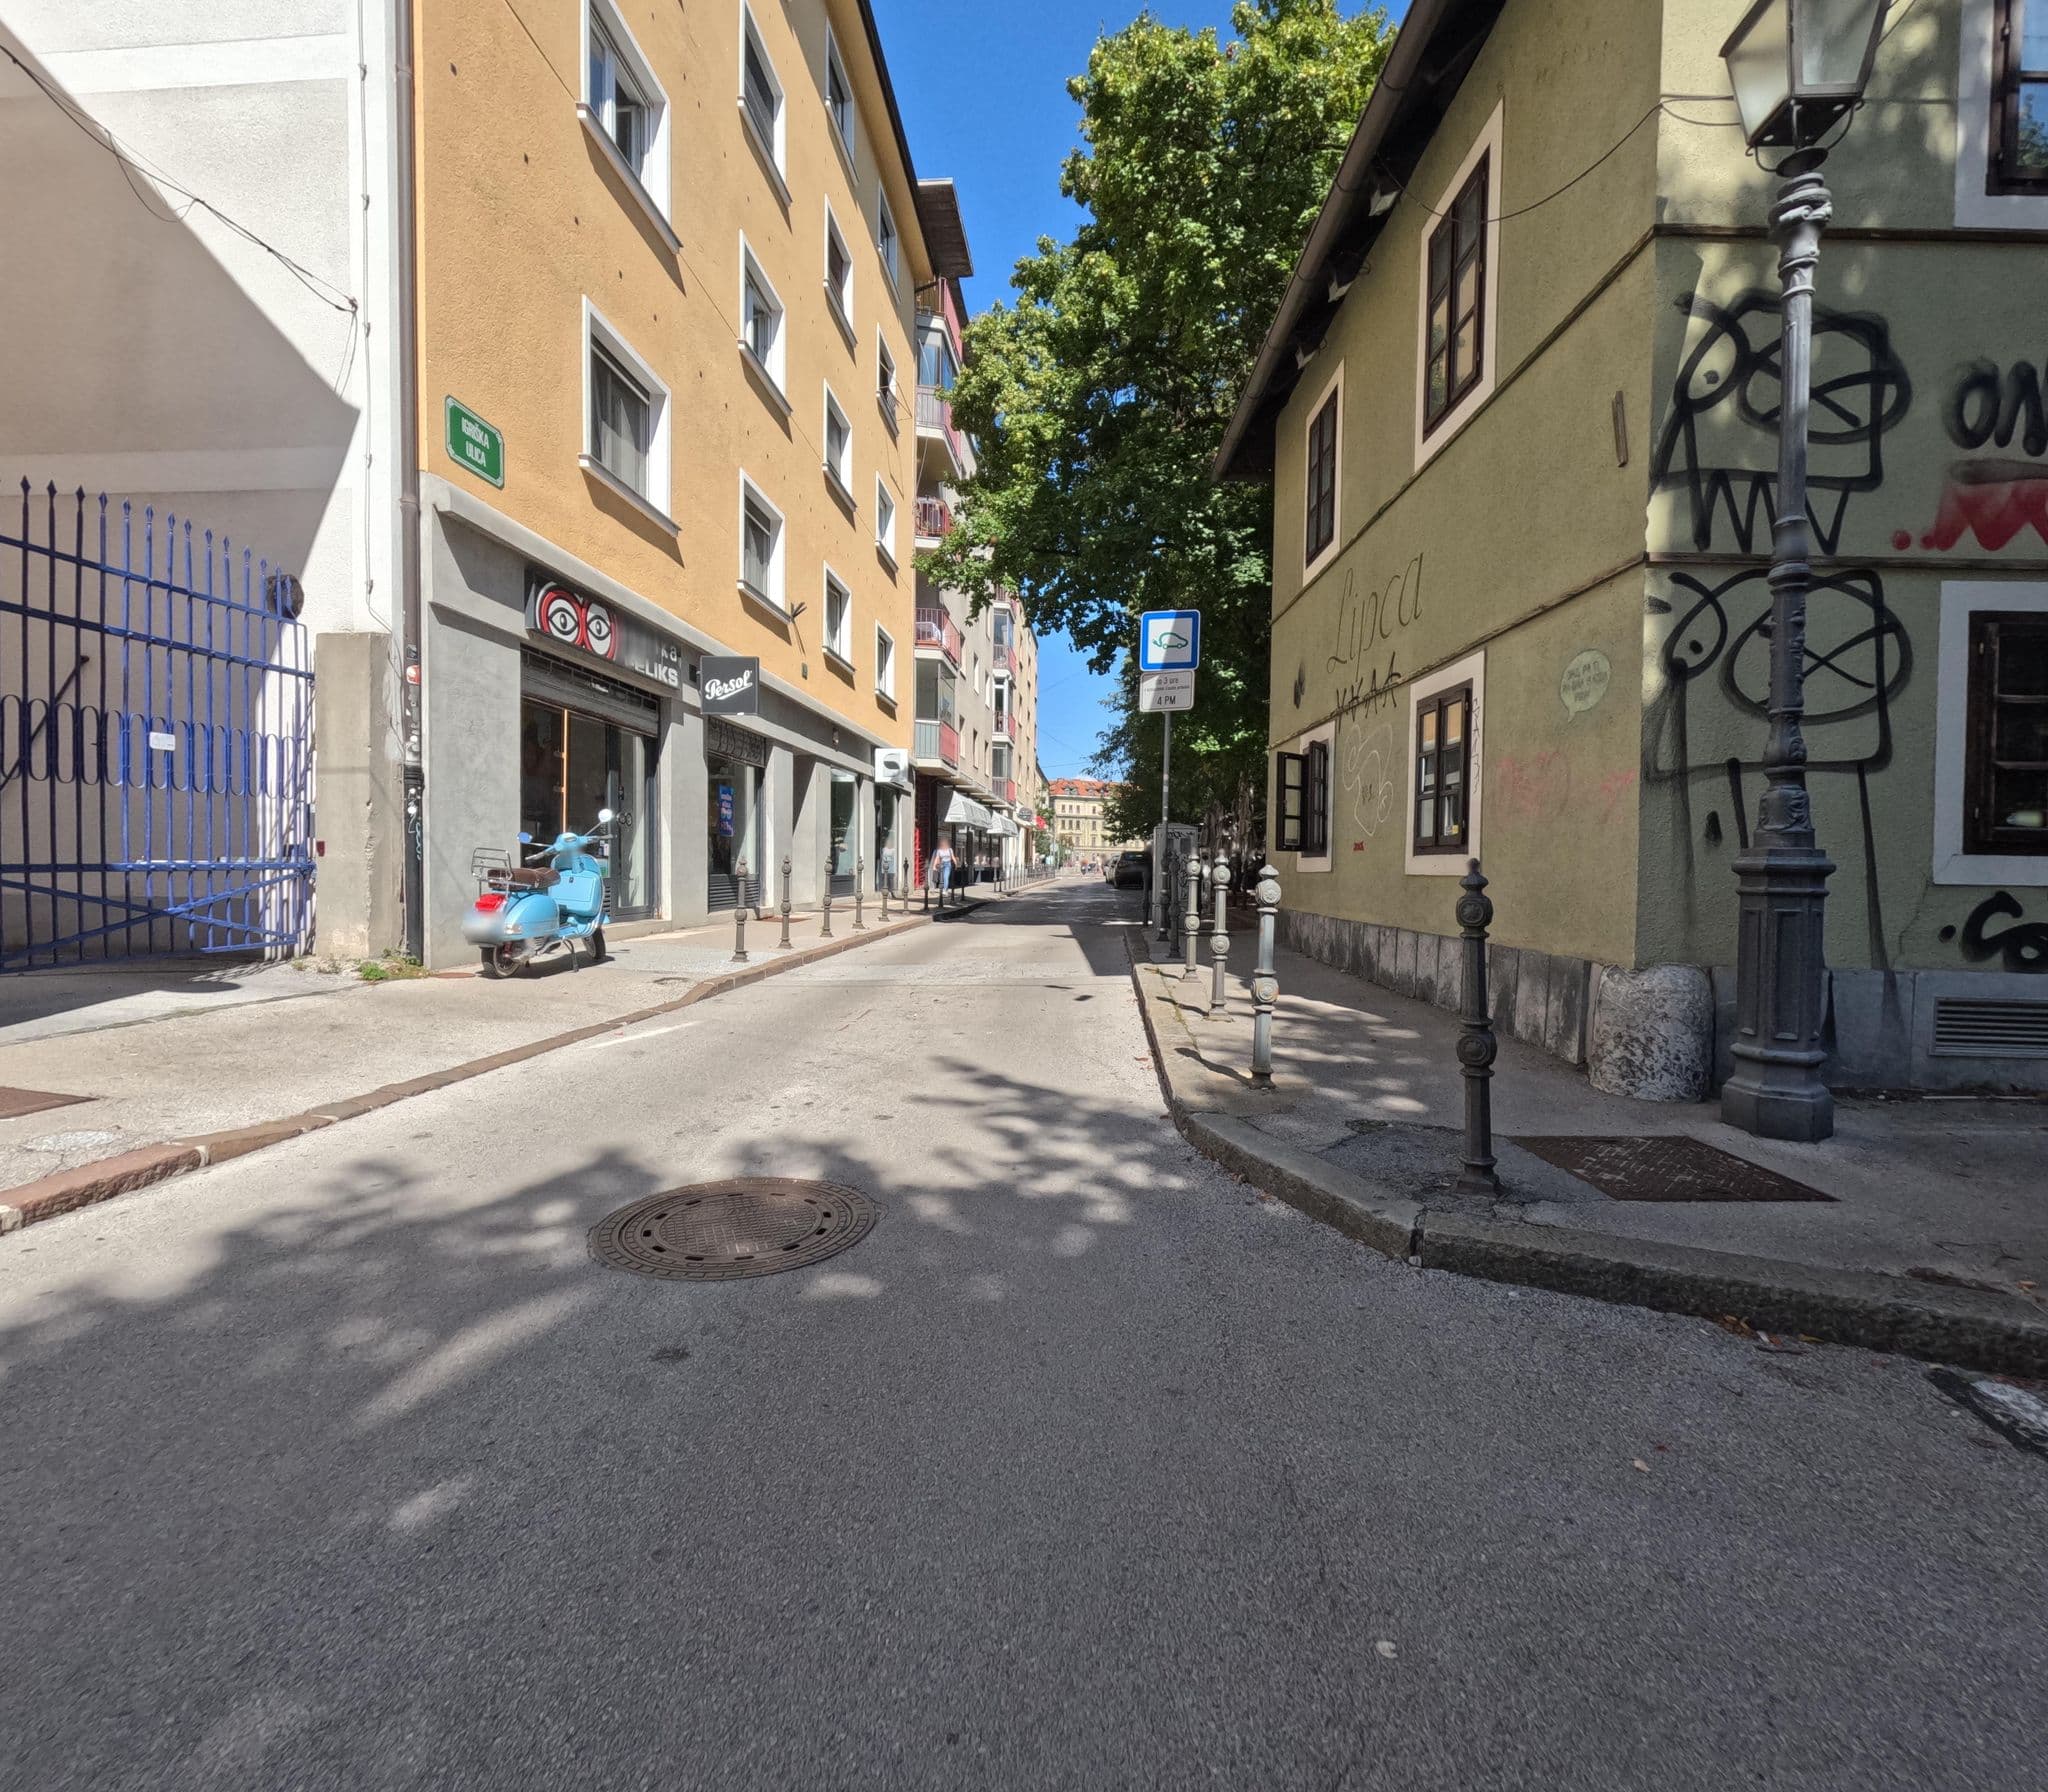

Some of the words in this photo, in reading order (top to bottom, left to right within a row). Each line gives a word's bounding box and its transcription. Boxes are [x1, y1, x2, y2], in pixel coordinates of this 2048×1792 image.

[465, 440, 487, 468] ULICA
[1327, 552, 1423, 683] Lipca
[704, 669, 753, 700] Persol
[1156, 696, 1162, 706] 4
[1164, 695, 1177, 706] PM
